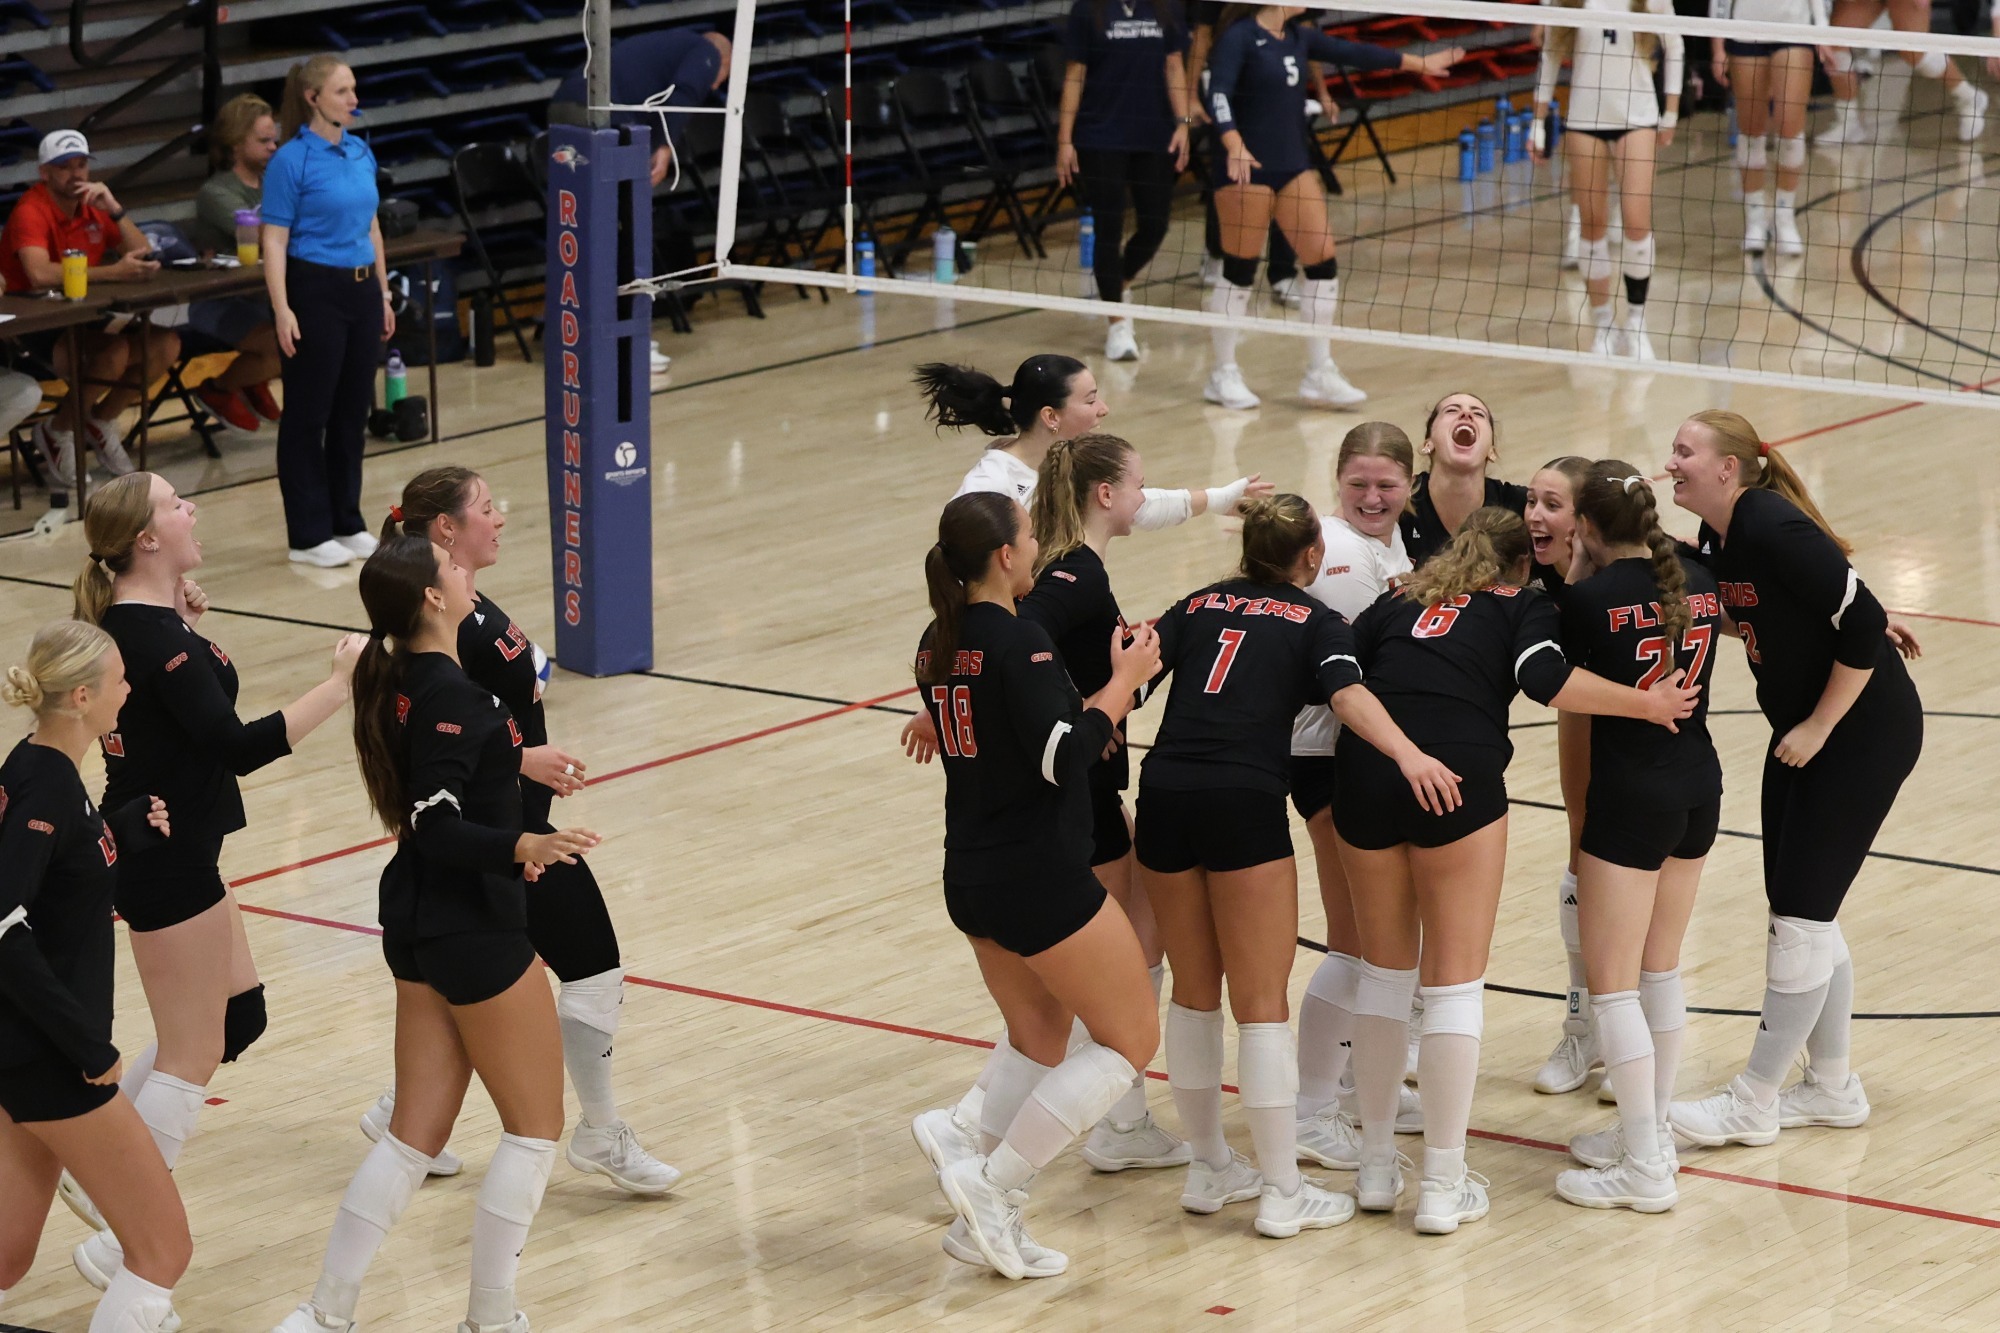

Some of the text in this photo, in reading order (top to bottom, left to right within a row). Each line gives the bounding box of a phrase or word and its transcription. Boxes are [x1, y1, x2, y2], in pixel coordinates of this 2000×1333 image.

[1283, 56, 1299, 87] 5
[559, 189, 582, 626] ROADRUNNERS
[1326, 566, 1351, 576] GLVC
[1186, 592, 1312, 624] FLYERS
[1411, 594, 1471, 638] 6
[1607, 592, 1719, 632] FLYRS
[917, 650, 984, 676] FERS
[1203, 627, 1247, 694] 1
[1635, 624, 1712, 691] 27
[931, 685, 978, 758] 18
